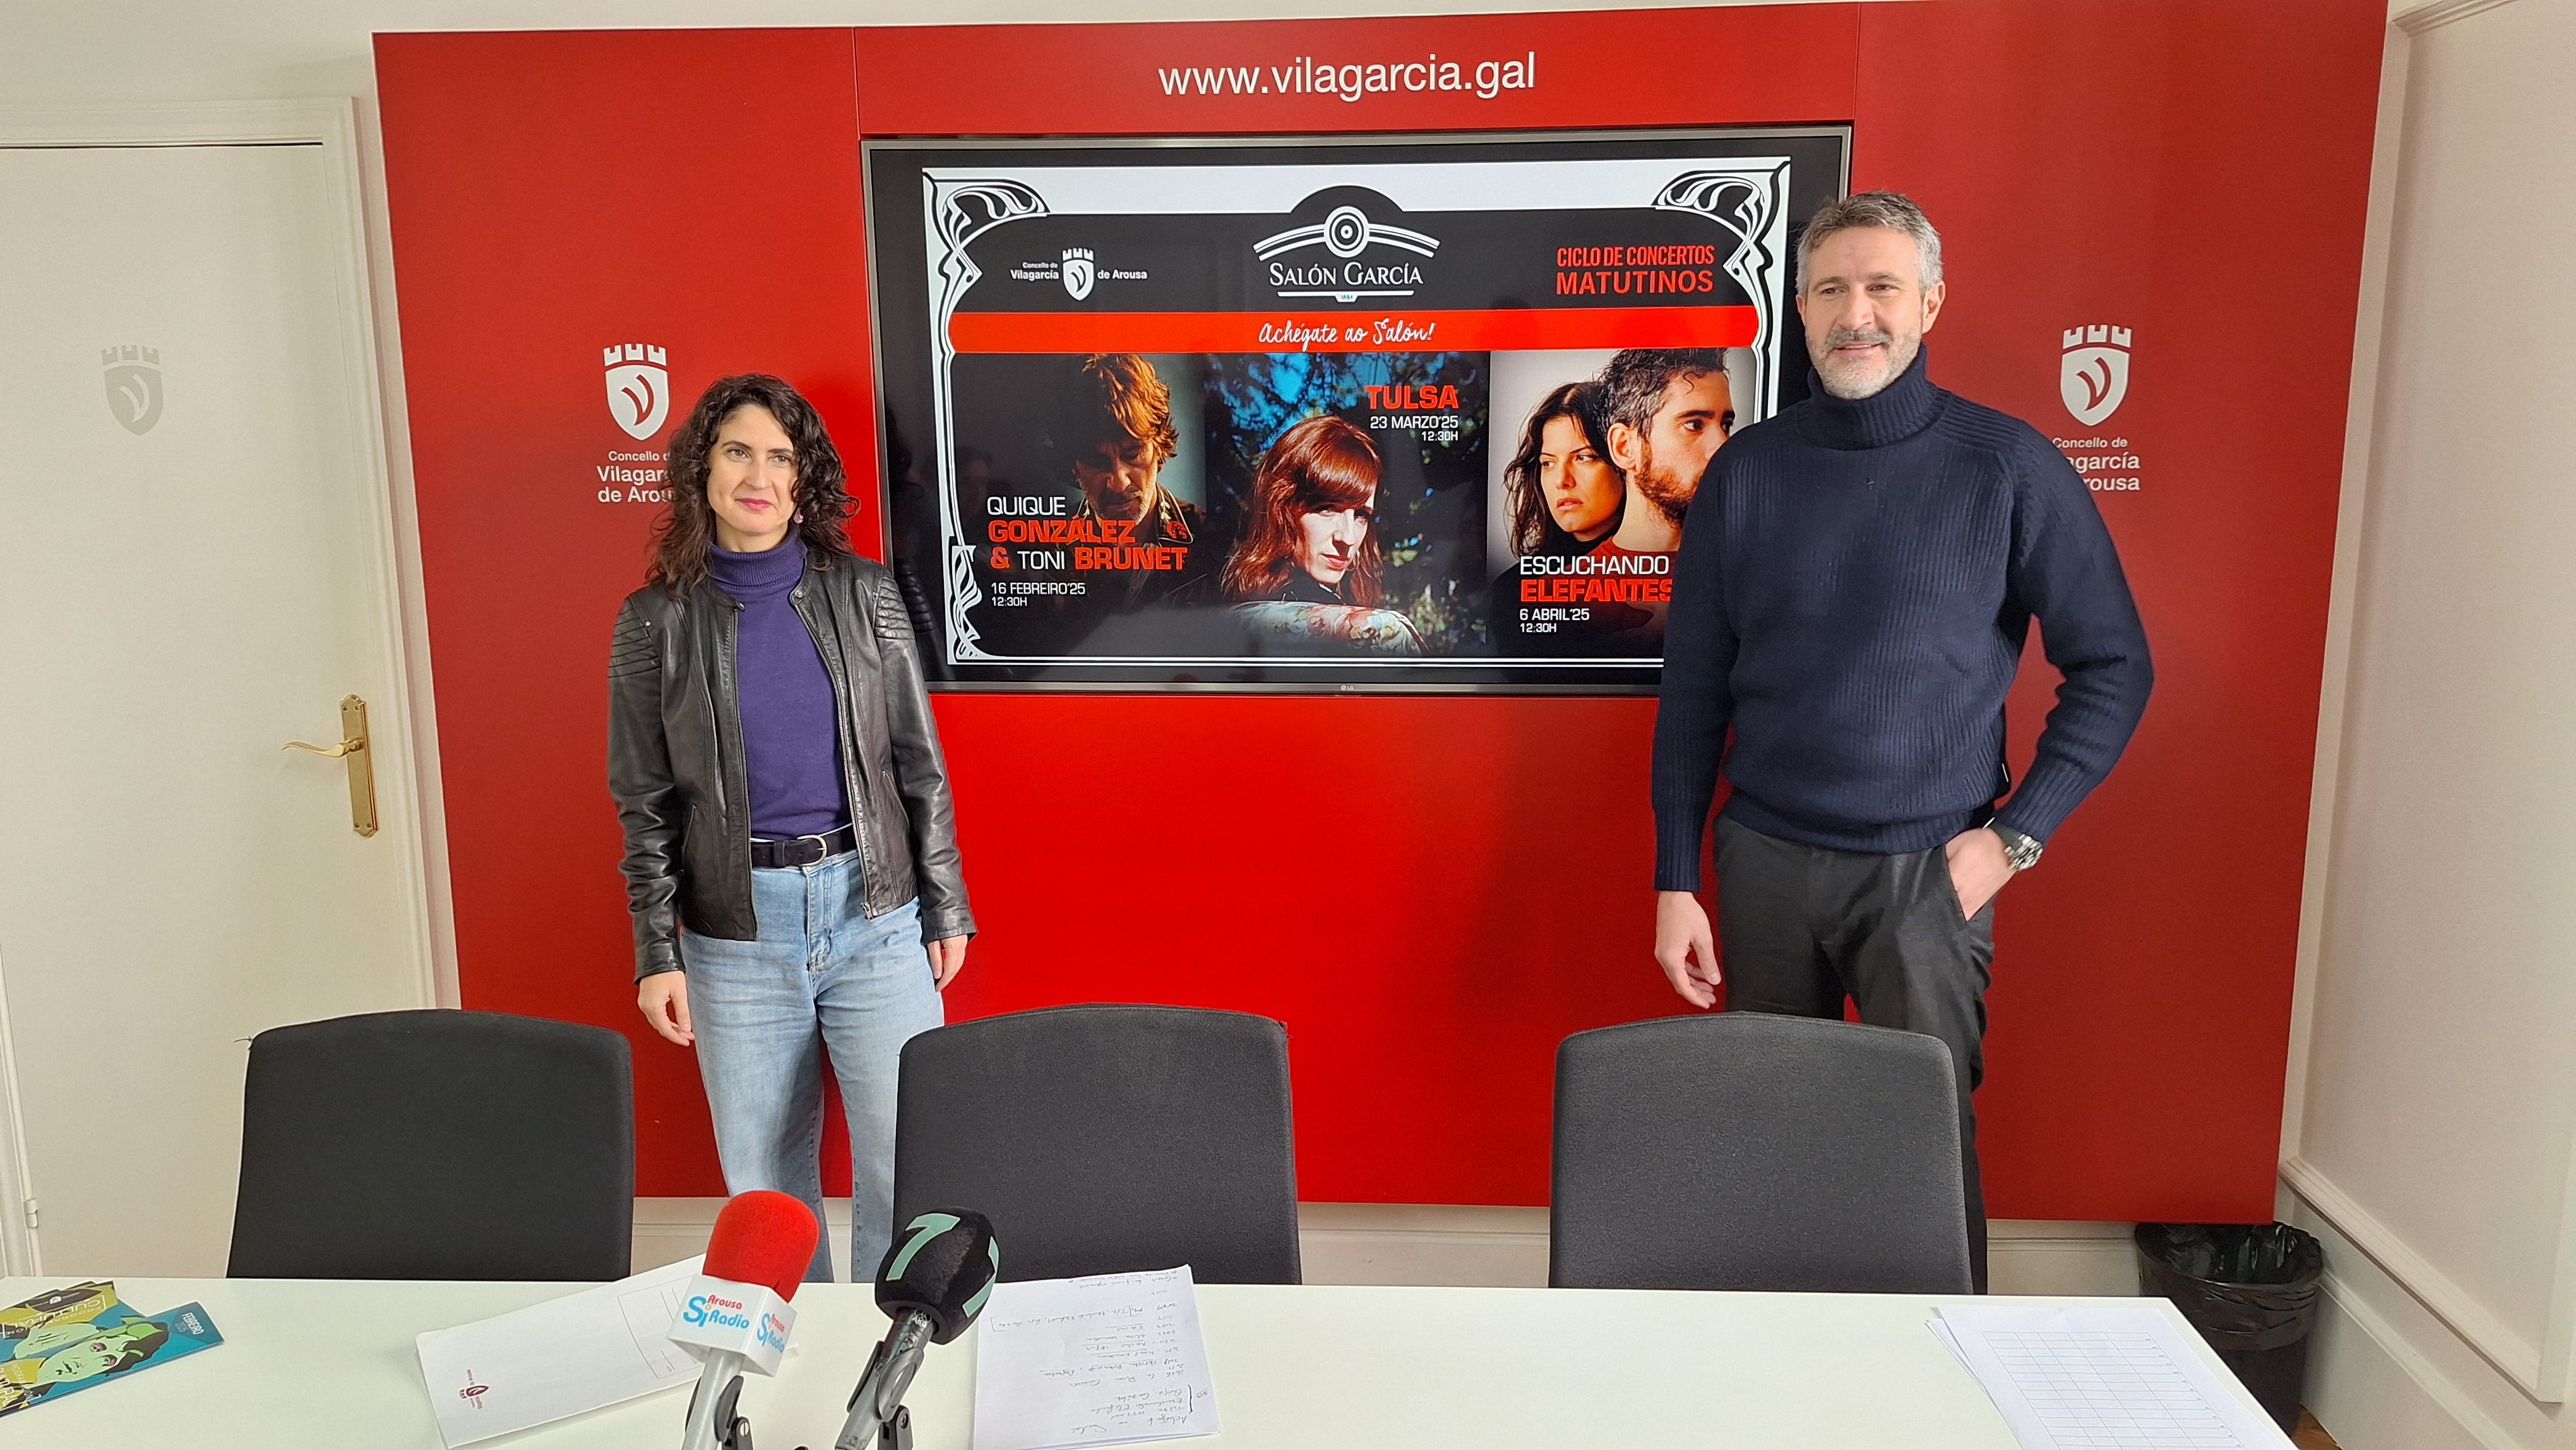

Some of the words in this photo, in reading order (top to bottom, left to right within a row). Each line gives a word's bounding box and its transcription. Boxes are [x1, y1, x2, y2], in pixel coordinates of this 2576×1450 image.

[1158, 51, 1535, 102] www.vilagarcia.gal
[1556, 247, 1601, 267] CICLO
[1603, 246, 1624, 267] DE
[1626, 245, 1716, 266] CONCERTOS
[1010, 269, 1059, 281] Vilagarcía
[1097, 270, 1111, 279] de
[1112, 270, 1148, 279] Arousa
[1270, 262, 1337, 285] SALÓN
[1344, 261, 1424, 285] GARCÍA
[1556, 270, 1714, 295] MATUTINOS
[1259, 320, 1339, 352] Achégate
[1345, 325, 1369, 342] ao
[1373, 318, 1435, 345] Salón!
[1364, 385, 1459, 409] TULSA
[1370, 416, 1388, 429] 23
[1421, 431, 1458, 441] 12:30H
[2052, 436, 2108, 448] Concello
[2111, 436, 2128, 448] de
[608, 451, 660, 461] Concello
[663, 451, 671, 461] d
[2066, 452, 2140, 473] garcía
[596, 465, 673, 486] Vilagar
[2083, 476, 2140, 491] rousa
[597, 486, 622, 503] de
[627, 486, 674, 503] Arou
[987, 496, 1066, 516] QUIQUE
[988, 514, 1136, 543] GONZÁLEZ
[990, 546, 1010, 568] &
[1017, 551, 1065, 570] TONI
[1075, 547, 1188, 570] BRUNET
[1520, 556, 1669, 575] ESCUCHANDO
[991, 582, 1006, 594] 16
[1520, 578, 1673, 602] ELEFANTES
[991, 597, 1027, 606] 12:30H
[1520, 609, 1529, 620] 6
[1520, 623, 1557, 633] 12:30H
[707, 1295, 743, 1310] Arousa
[181, 1312, 205, 1334] FEBREIRO
[708, 1309, 750, 1329] Radio
[770, 1313, 785, 1333] Arousa
[766, 1330, 785, 1353] Radio
